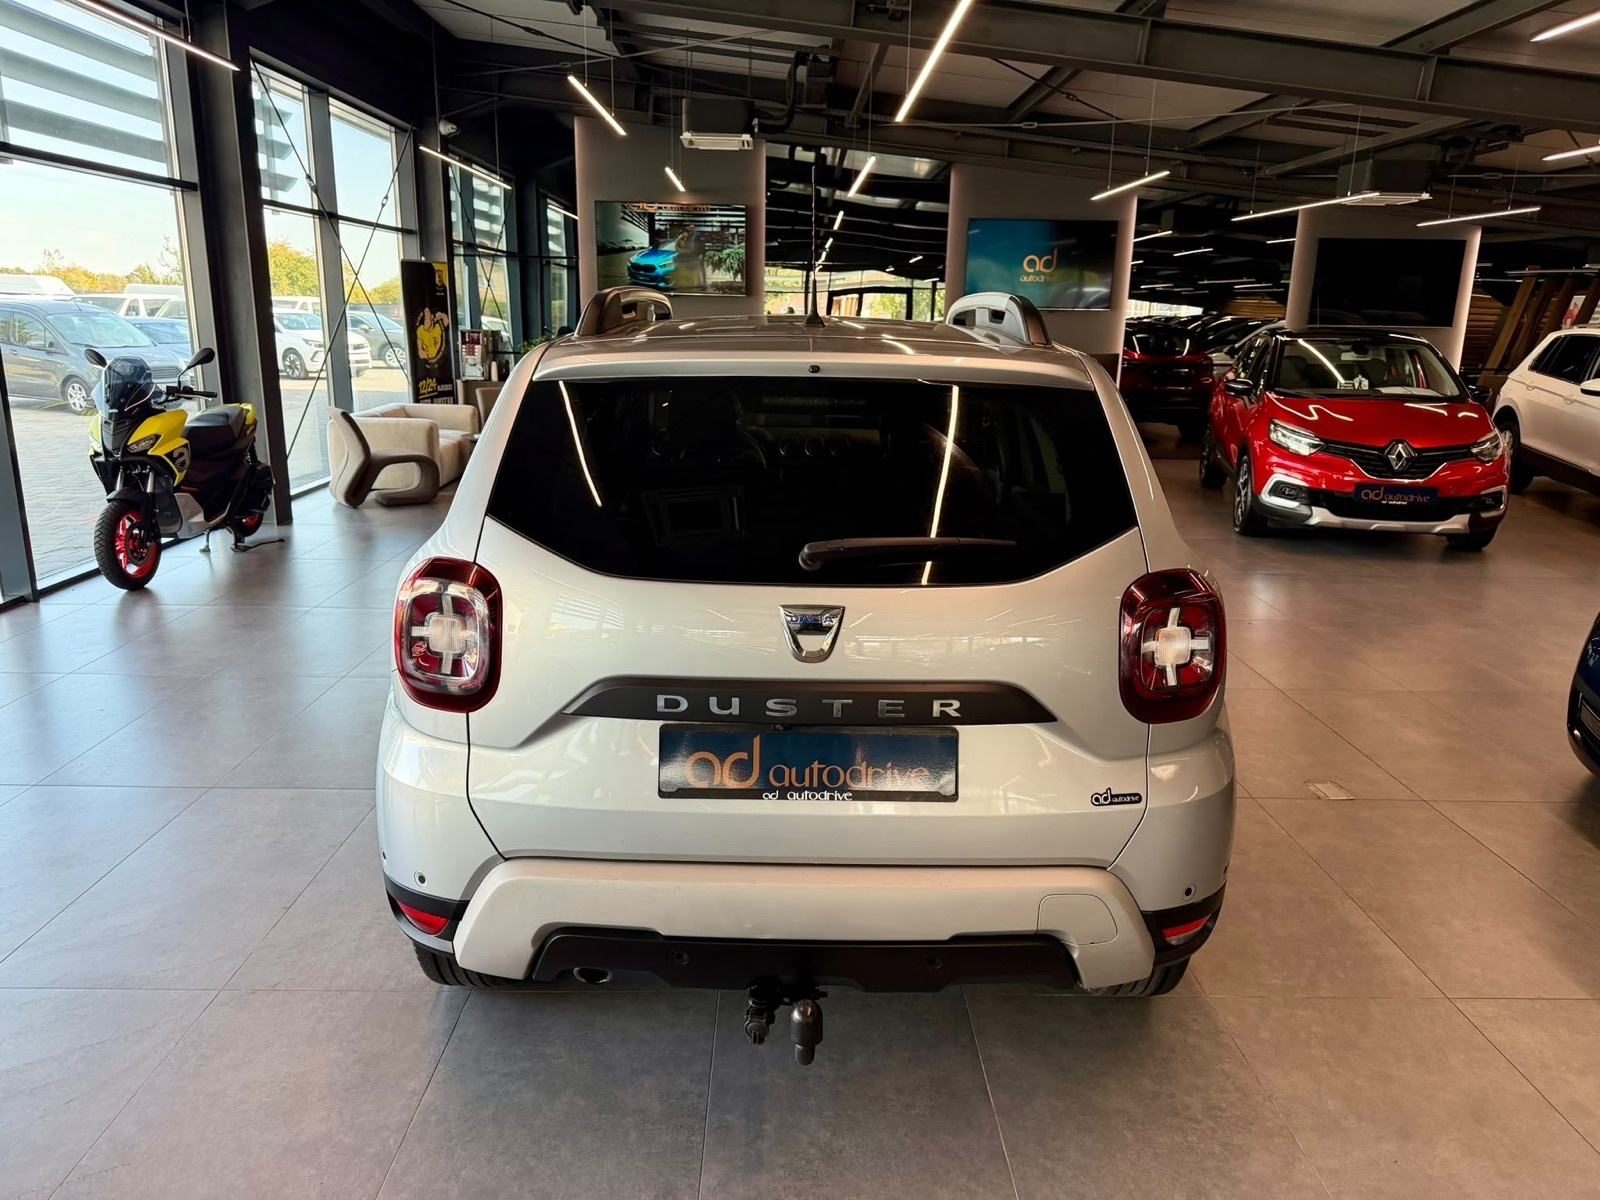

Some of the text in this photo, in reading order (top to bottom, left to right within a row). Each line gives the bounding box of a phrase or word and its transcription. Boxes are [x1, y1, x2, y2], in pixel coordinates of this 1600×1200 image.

[1023, 247, 1058, 273] ad
[1019, 274, 1057, 282] autodri
[1361, 486, 1431, 502] ad autodrive
[790, 615, 834, 624] DACIA
[656, 694, 963, 718] DUSTER
[686, 734, 931, 789] ad autodrive
[762, 790, 853, 801] ad autodrive
[1092, 788, 1140, 805] ad autodrive
